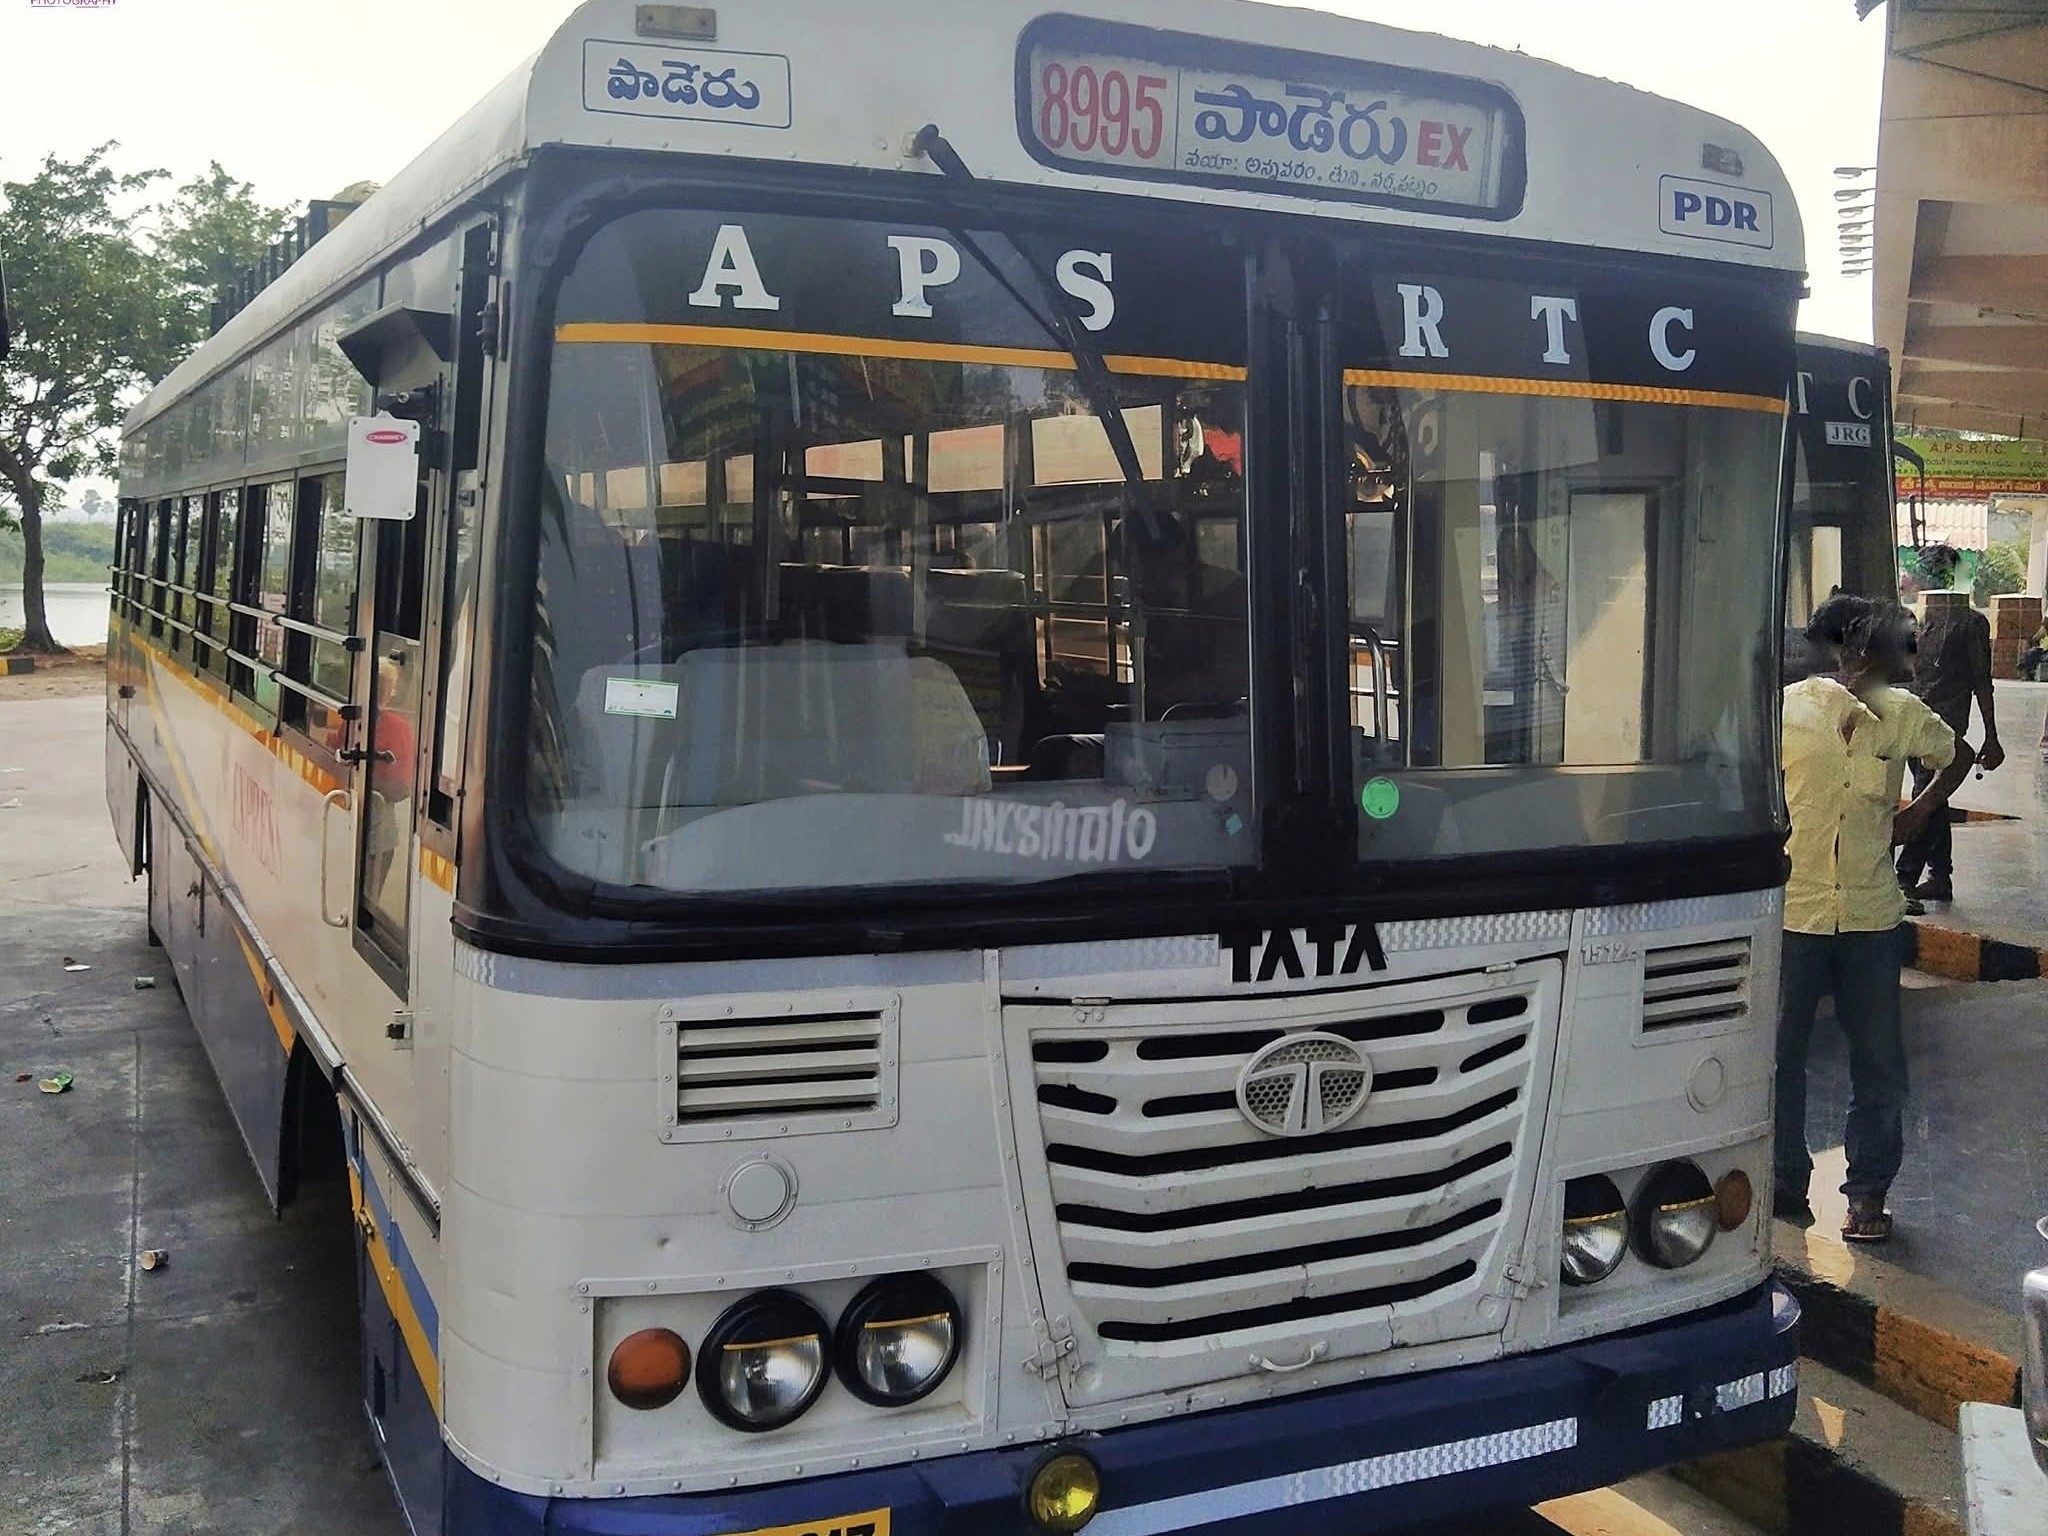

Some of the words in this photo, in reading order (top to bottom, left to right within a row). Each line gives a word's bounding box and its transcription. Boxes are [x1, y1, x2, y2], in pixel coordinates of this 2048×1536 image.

[607, 57, 761, 110] పాడేరు
[1040, 62, 1168, 161] 8995
[1194, 83, 1408, 165] పాడేరు
[1416, 119, 1473, 171] EX
[1673, 191, 1760, 232] PDR
[1831, 426, 1867, 441] JRG
[1219, 924, 1388, 983] TATA
